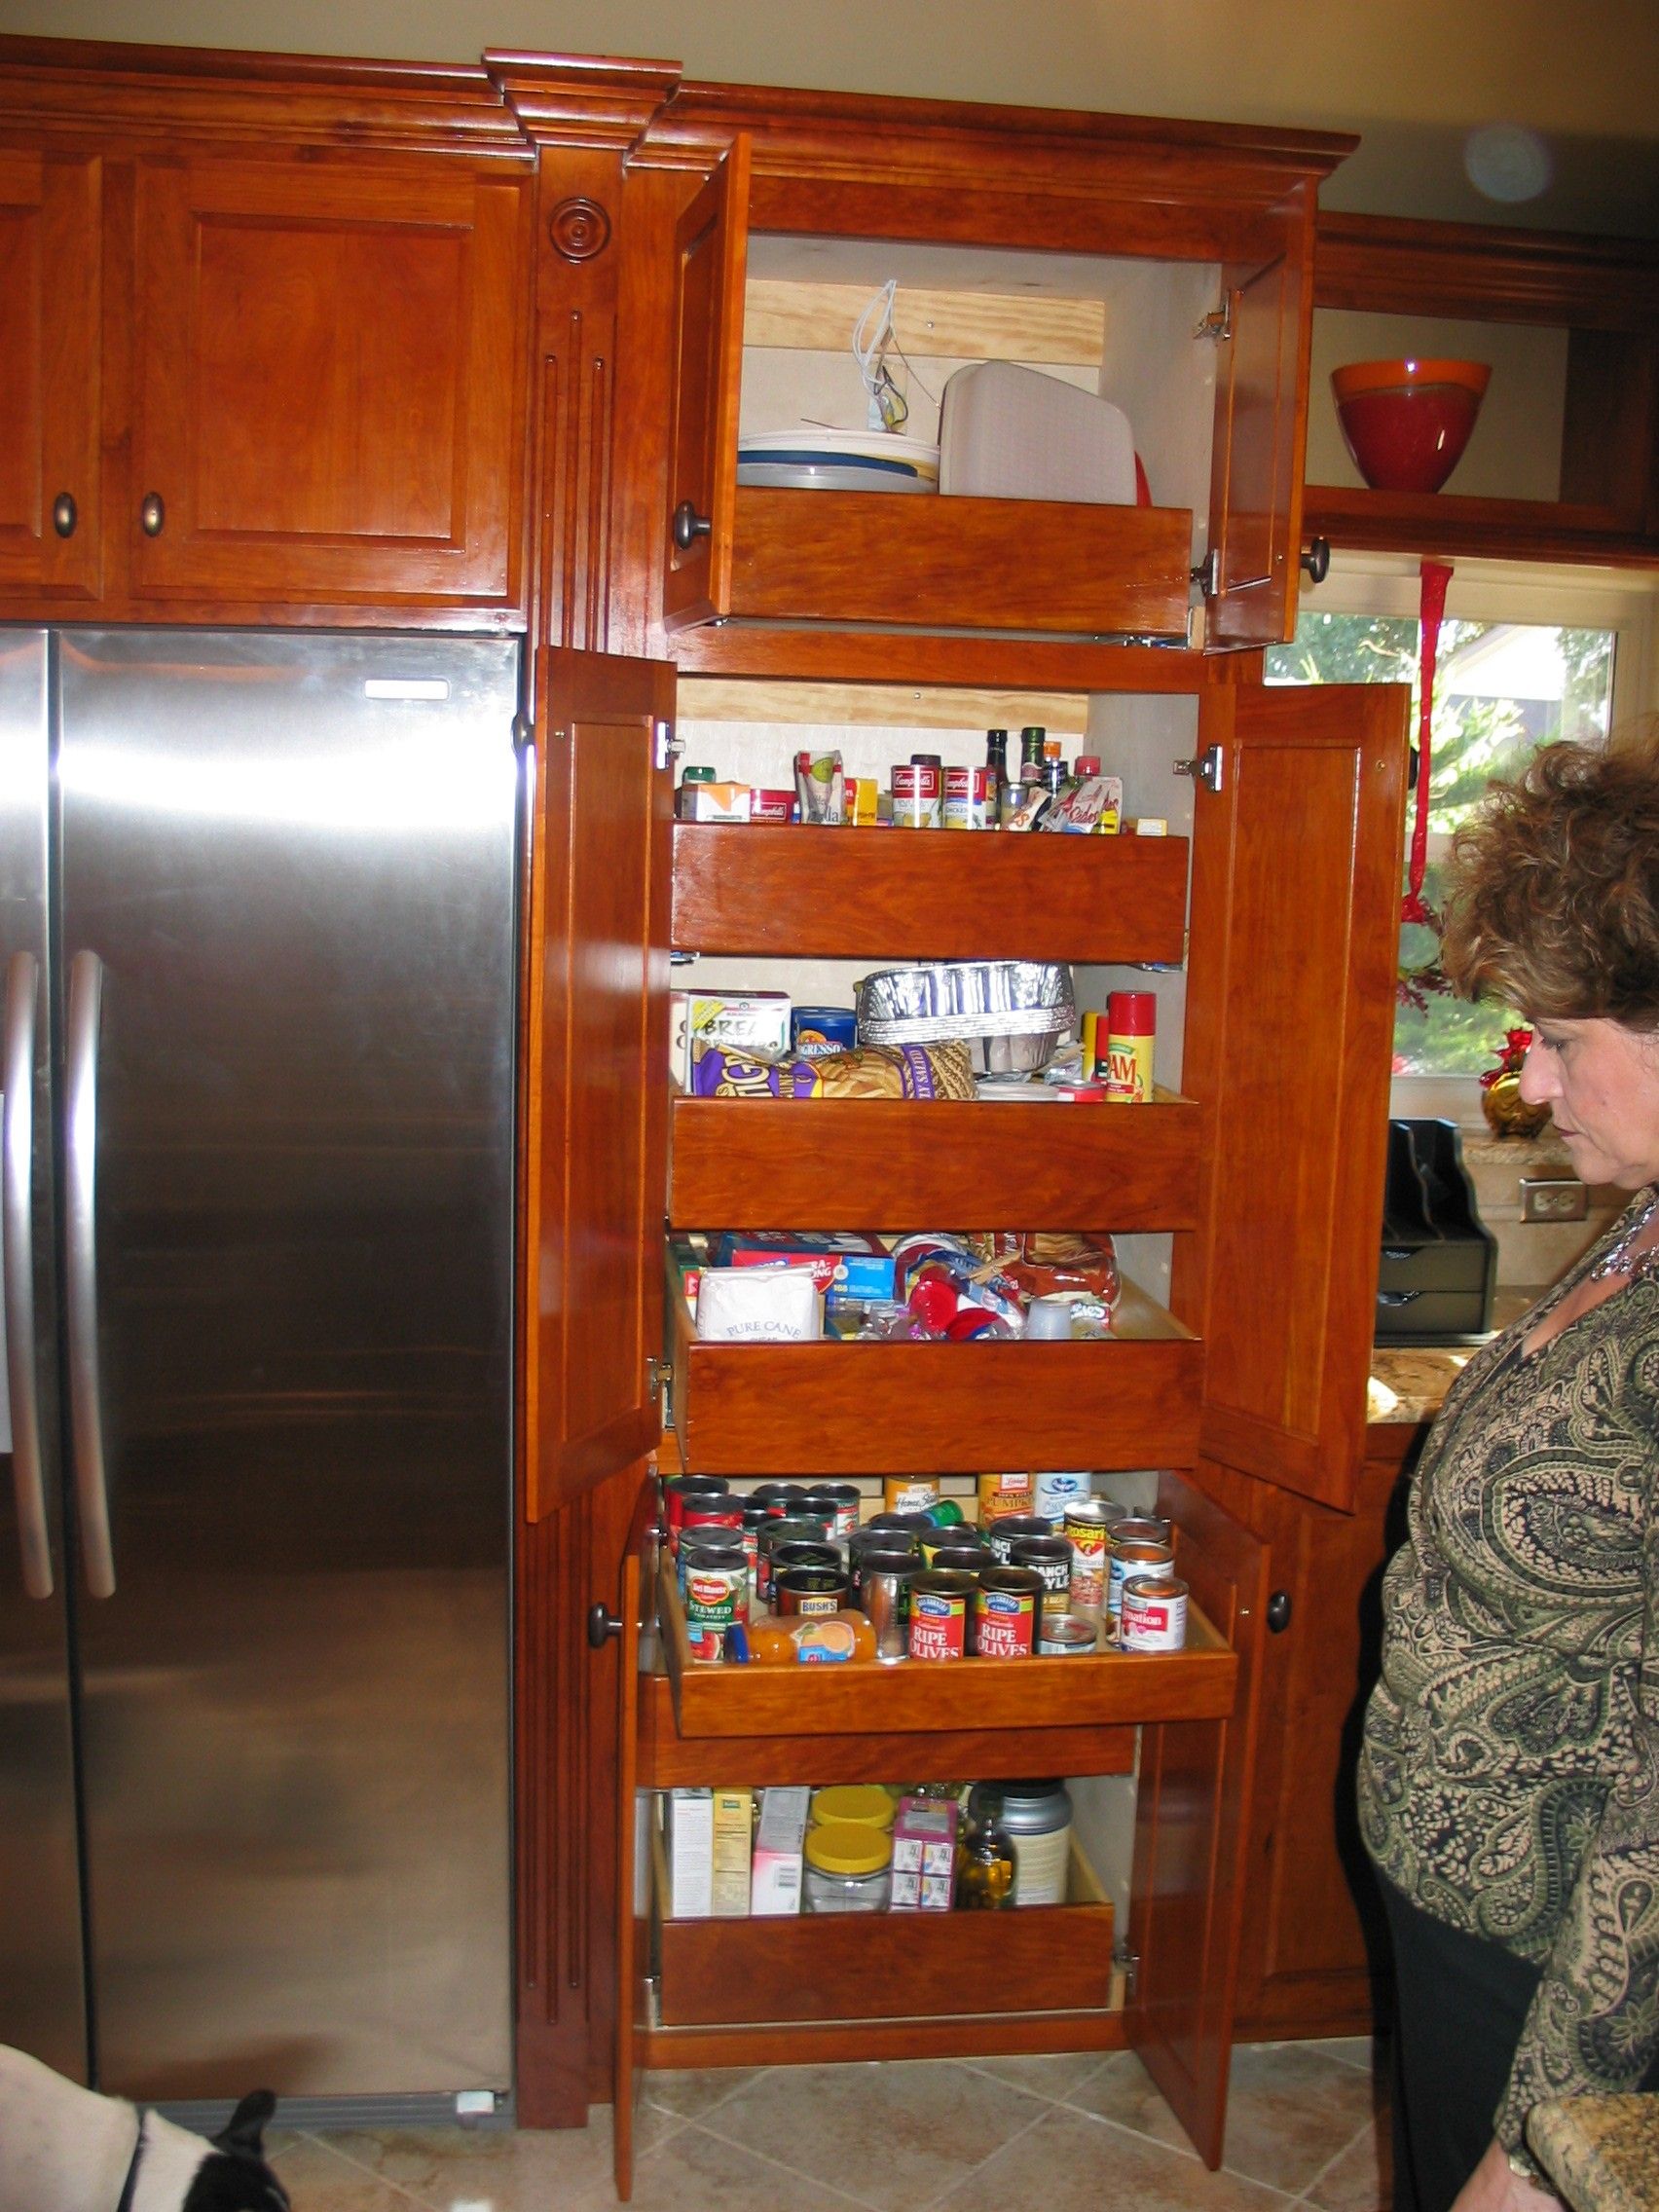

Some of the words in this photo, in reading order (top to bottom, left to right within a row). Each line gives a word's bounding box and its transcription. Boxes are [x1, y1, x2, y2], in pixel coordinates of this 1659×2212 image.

[800, 1044, 842, 1055] GRESSO
[1107, 1054, 1137, 1085] AM
[726, 1321, 761, 1337] PURE
[763, 1320, 802, 1340] CANE
[689, 1600, 732, 1615] STEWED
[802, 1601, 837, 1612] BUSH'S
[1124, 1610, 1162, 1626] nation
[914, 1624, 948, 1646] RIPE
[981, 1622, 1016, 1643] RIPE
[910, 1638, 960, 1659] OLIVES
[977, 1636, 1028, 1657] OLIVES
